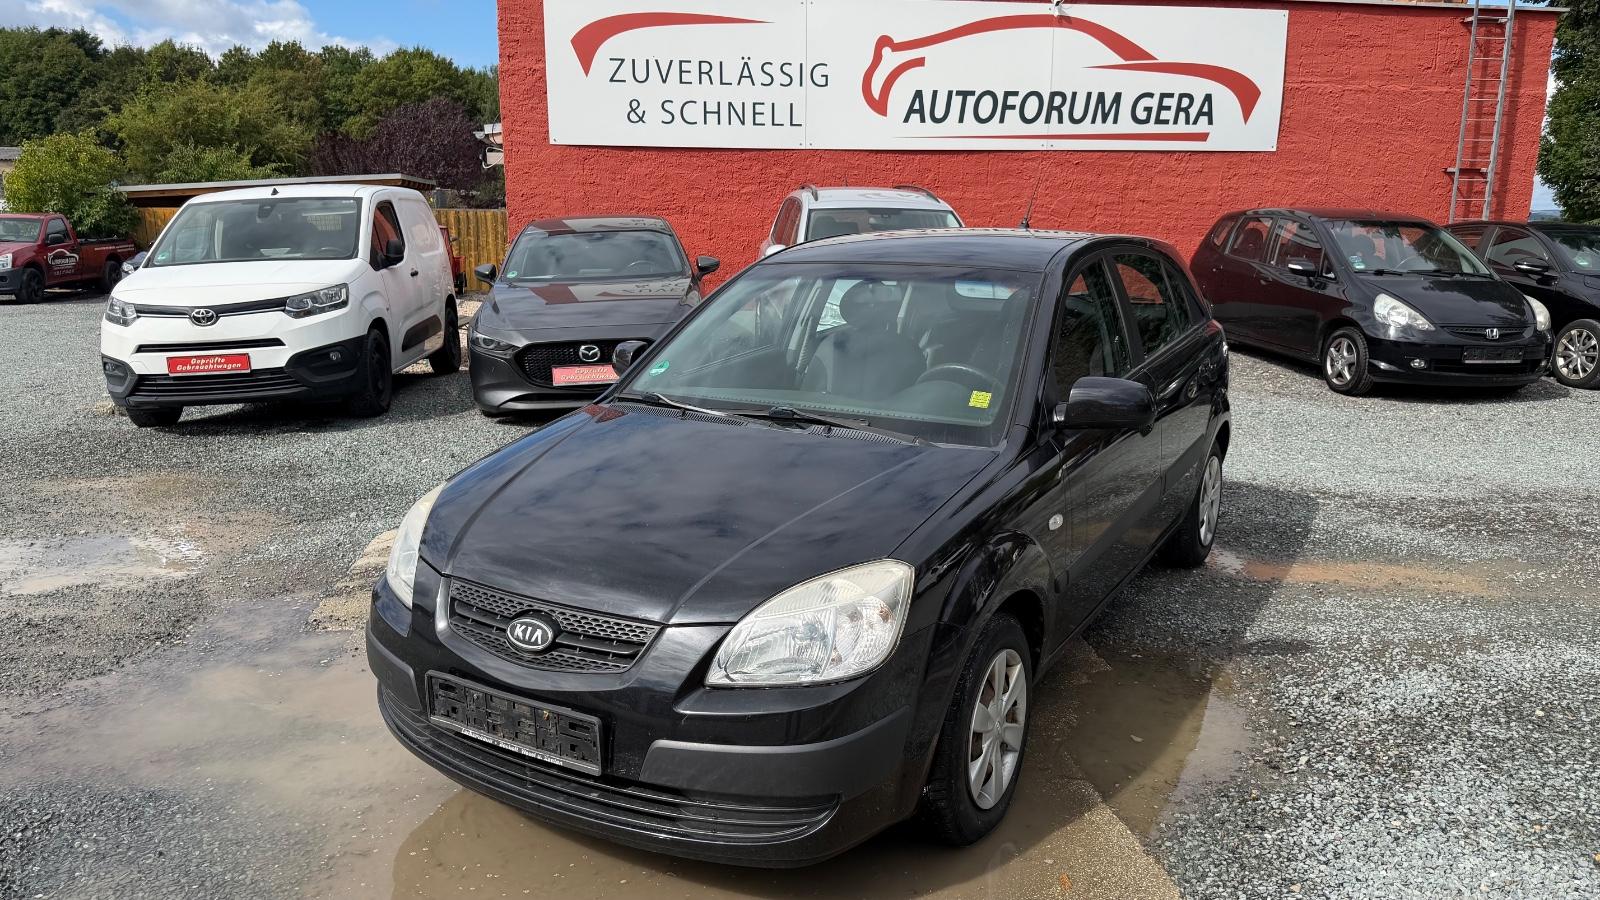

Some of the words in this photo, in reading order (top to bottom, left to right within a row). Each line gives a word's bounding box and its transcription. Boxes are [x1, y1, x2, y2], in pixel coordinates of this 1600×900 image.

[609, 56, 828, 87] ZUVERLÄSSIG
[627, 99, 646, 123] &
[661, 100, 802, 126] SCHNELL
[903, 89, 1122, 125] AUTOFORUM
[1130, 92, 1214, 125] GERA
[513, 624, 542, 644] KIA
